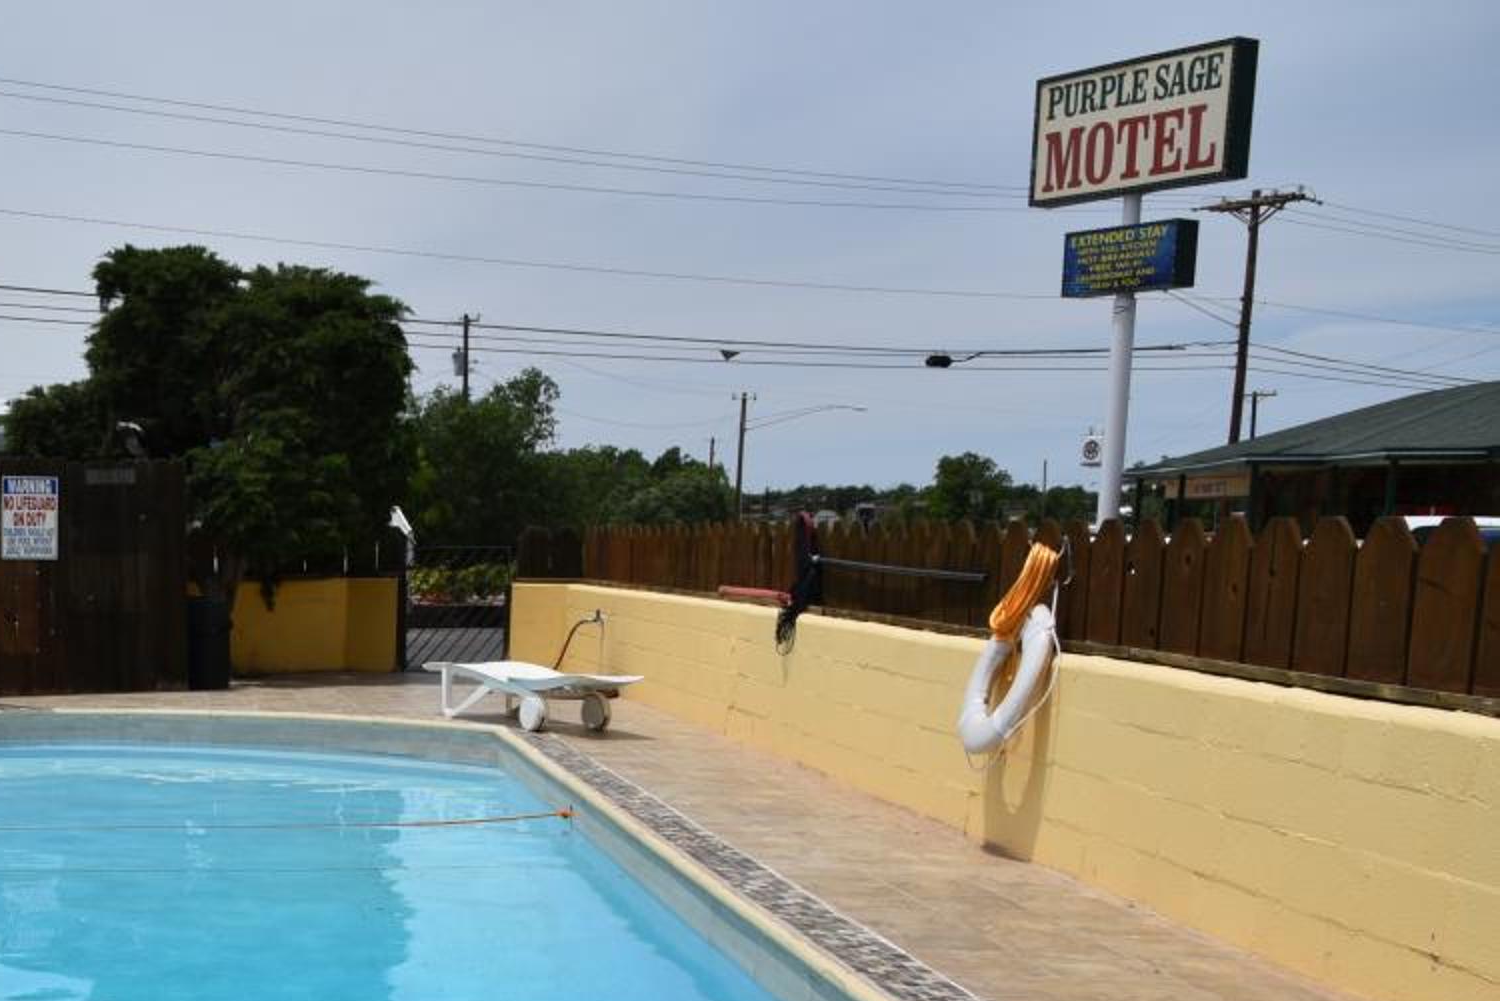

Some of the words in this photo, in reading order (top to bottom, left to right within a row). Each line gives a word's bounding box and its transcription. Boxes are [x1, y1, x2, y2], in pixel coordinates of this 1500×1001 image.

[1046, 68, 1149, 121] PURPLE
[1153, 52, 1225, 101] SAGE
[1041, 104, 1216, 193] MOTEL
[1070, 229, 1135, 249] EXTENDED
[1139, 224, 1169, 239] STAY
[8, 479, 52, 494] WARNING
[4, 496, 14, 510] NO
[15, 496, 55, 510] LIFEGUARD
[14, 512, 25, 526] ON
[26, 512, 46, 526] DUTY
